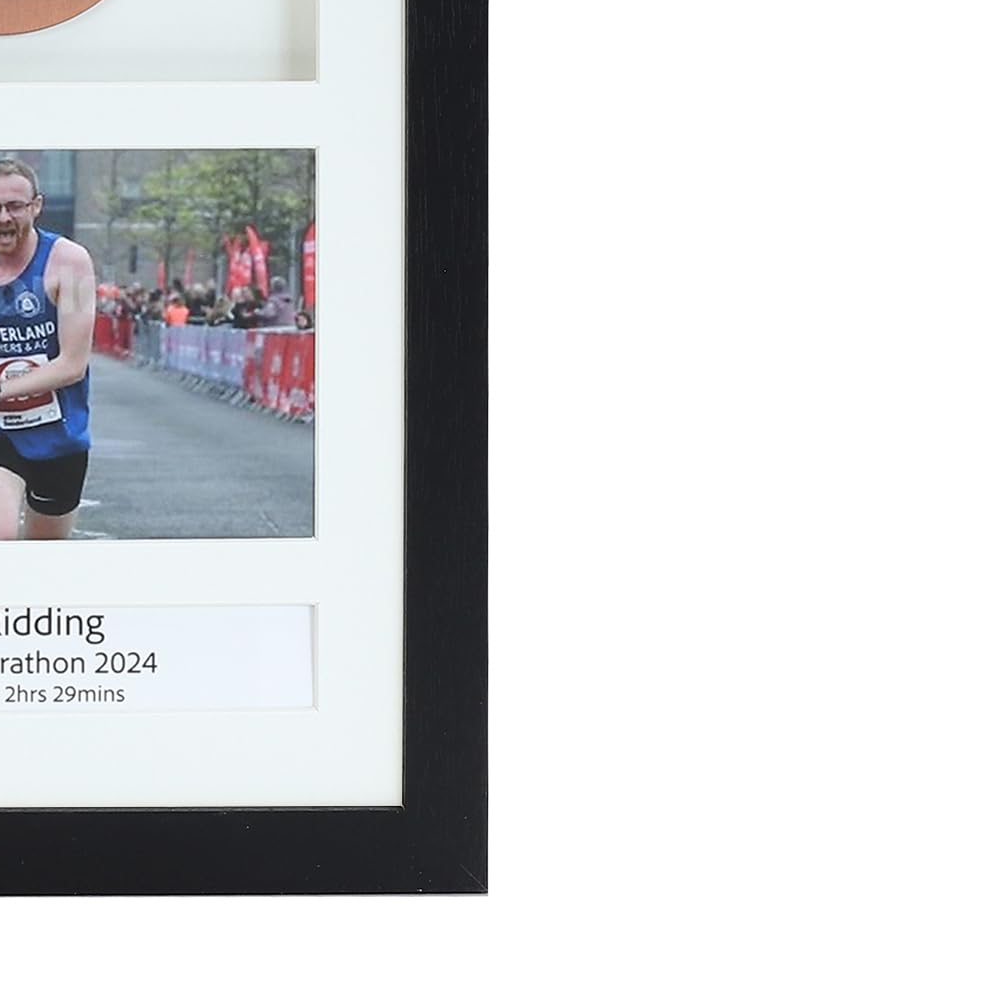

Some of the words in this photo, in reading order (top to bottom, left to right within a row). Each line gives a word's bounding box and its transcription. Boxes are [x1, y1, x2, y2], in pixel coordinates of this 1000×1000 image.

[94, 651, 158, 674] 2024
[4, 685, 47, 703] 2hrs
[53, 684, 125, 703] 29mins
